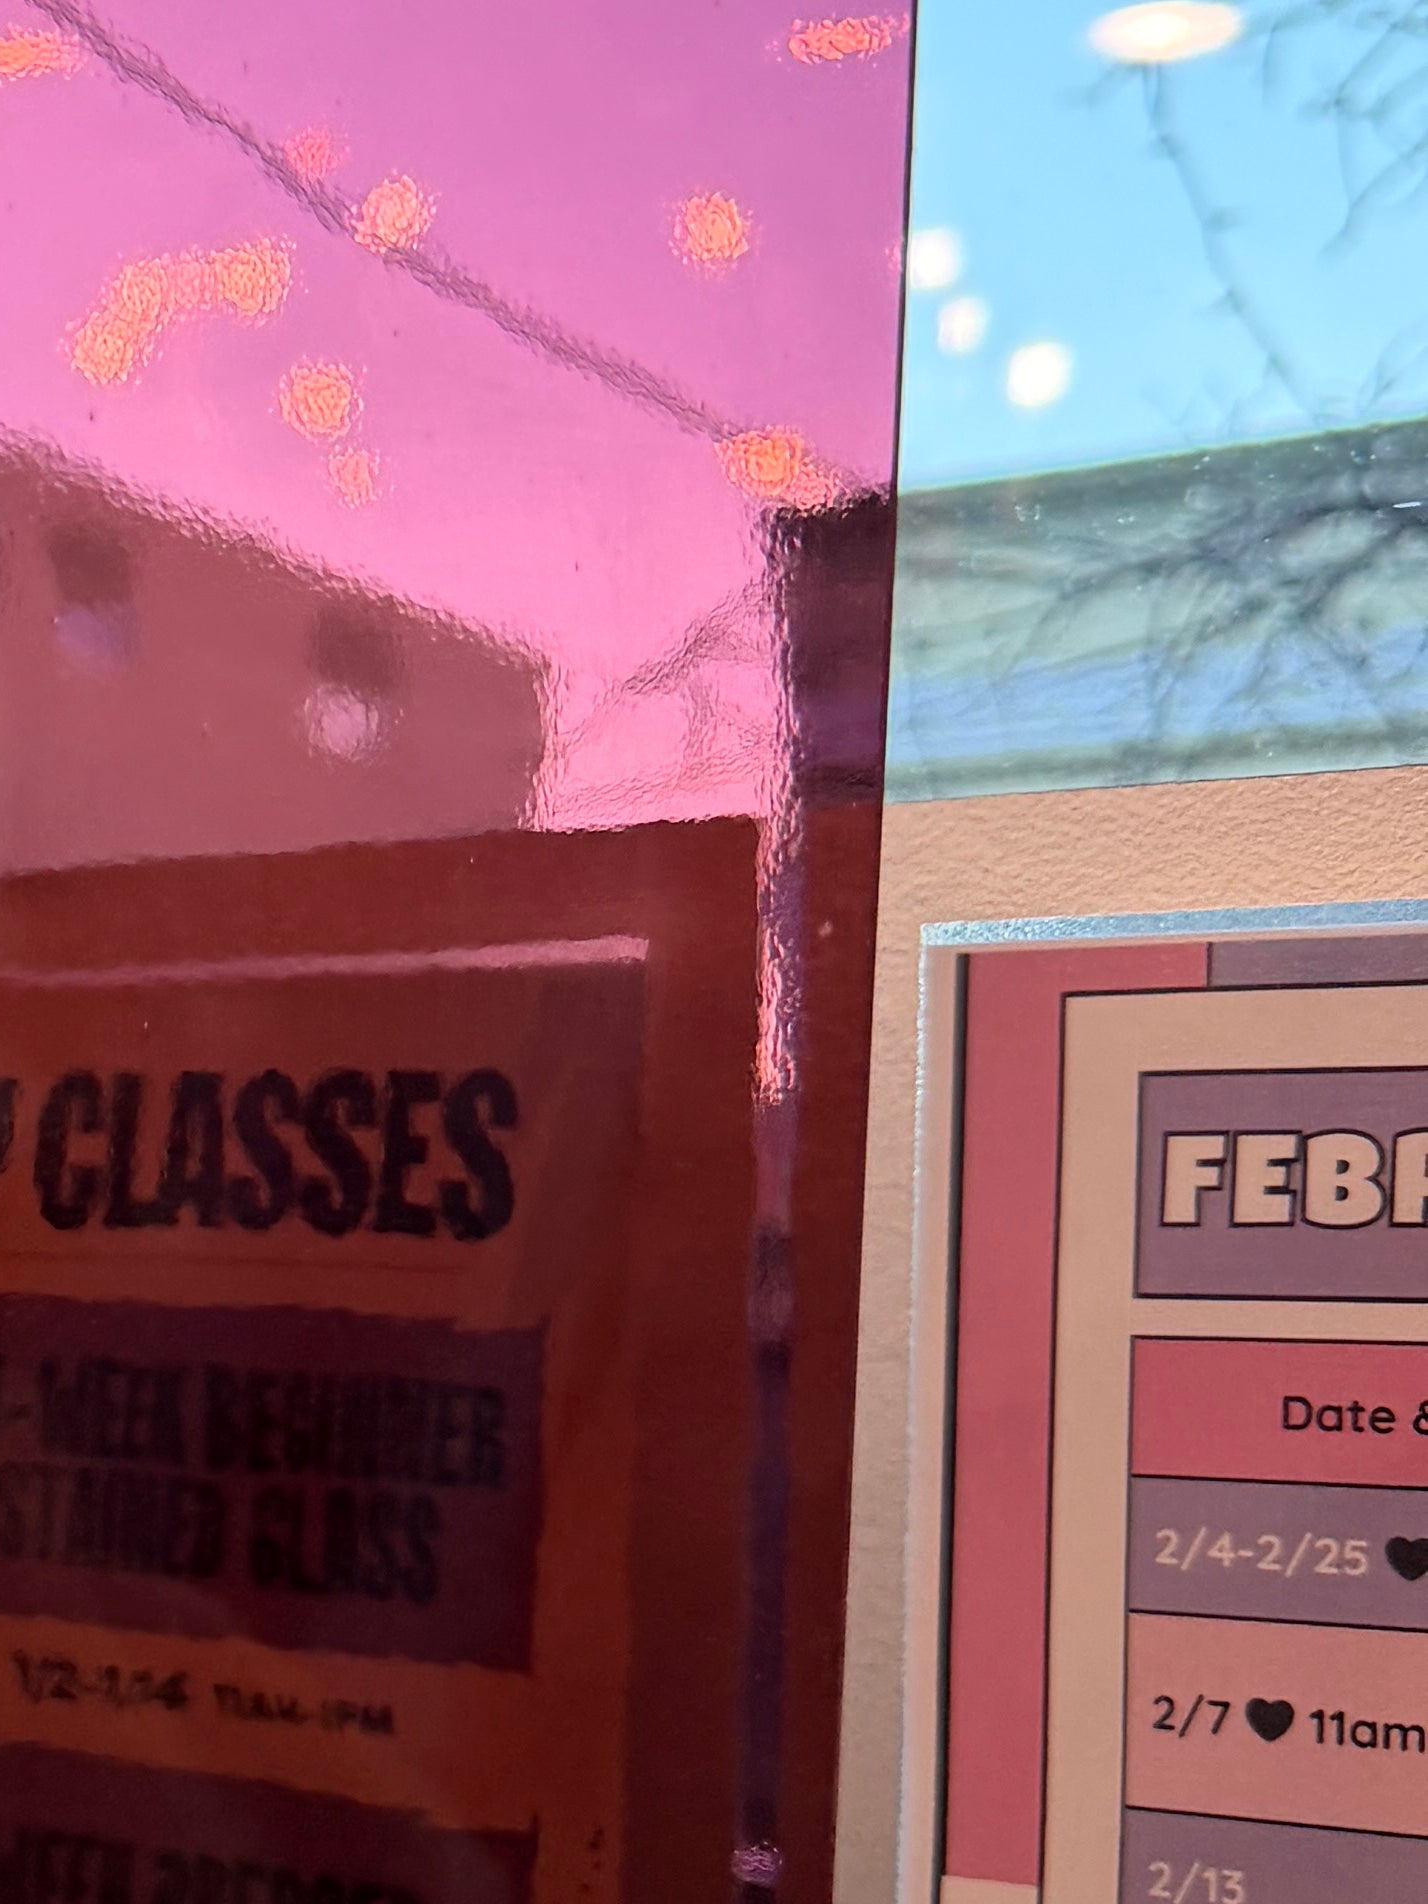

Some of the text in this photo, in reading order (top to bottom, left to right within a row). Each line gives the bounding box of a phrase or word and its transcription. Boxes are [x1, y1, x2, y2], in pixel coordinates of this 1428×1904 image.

[32, 1067, 520, 1242] CLASSES
[1282, 1394, 1396, 1435] Date
[249, 1482, 444, 1605] GLASS
[1154, 1526, 1369, 1579] 2/4-2/25
[1152, 1693, 1427, 1754] 2/7 11am
